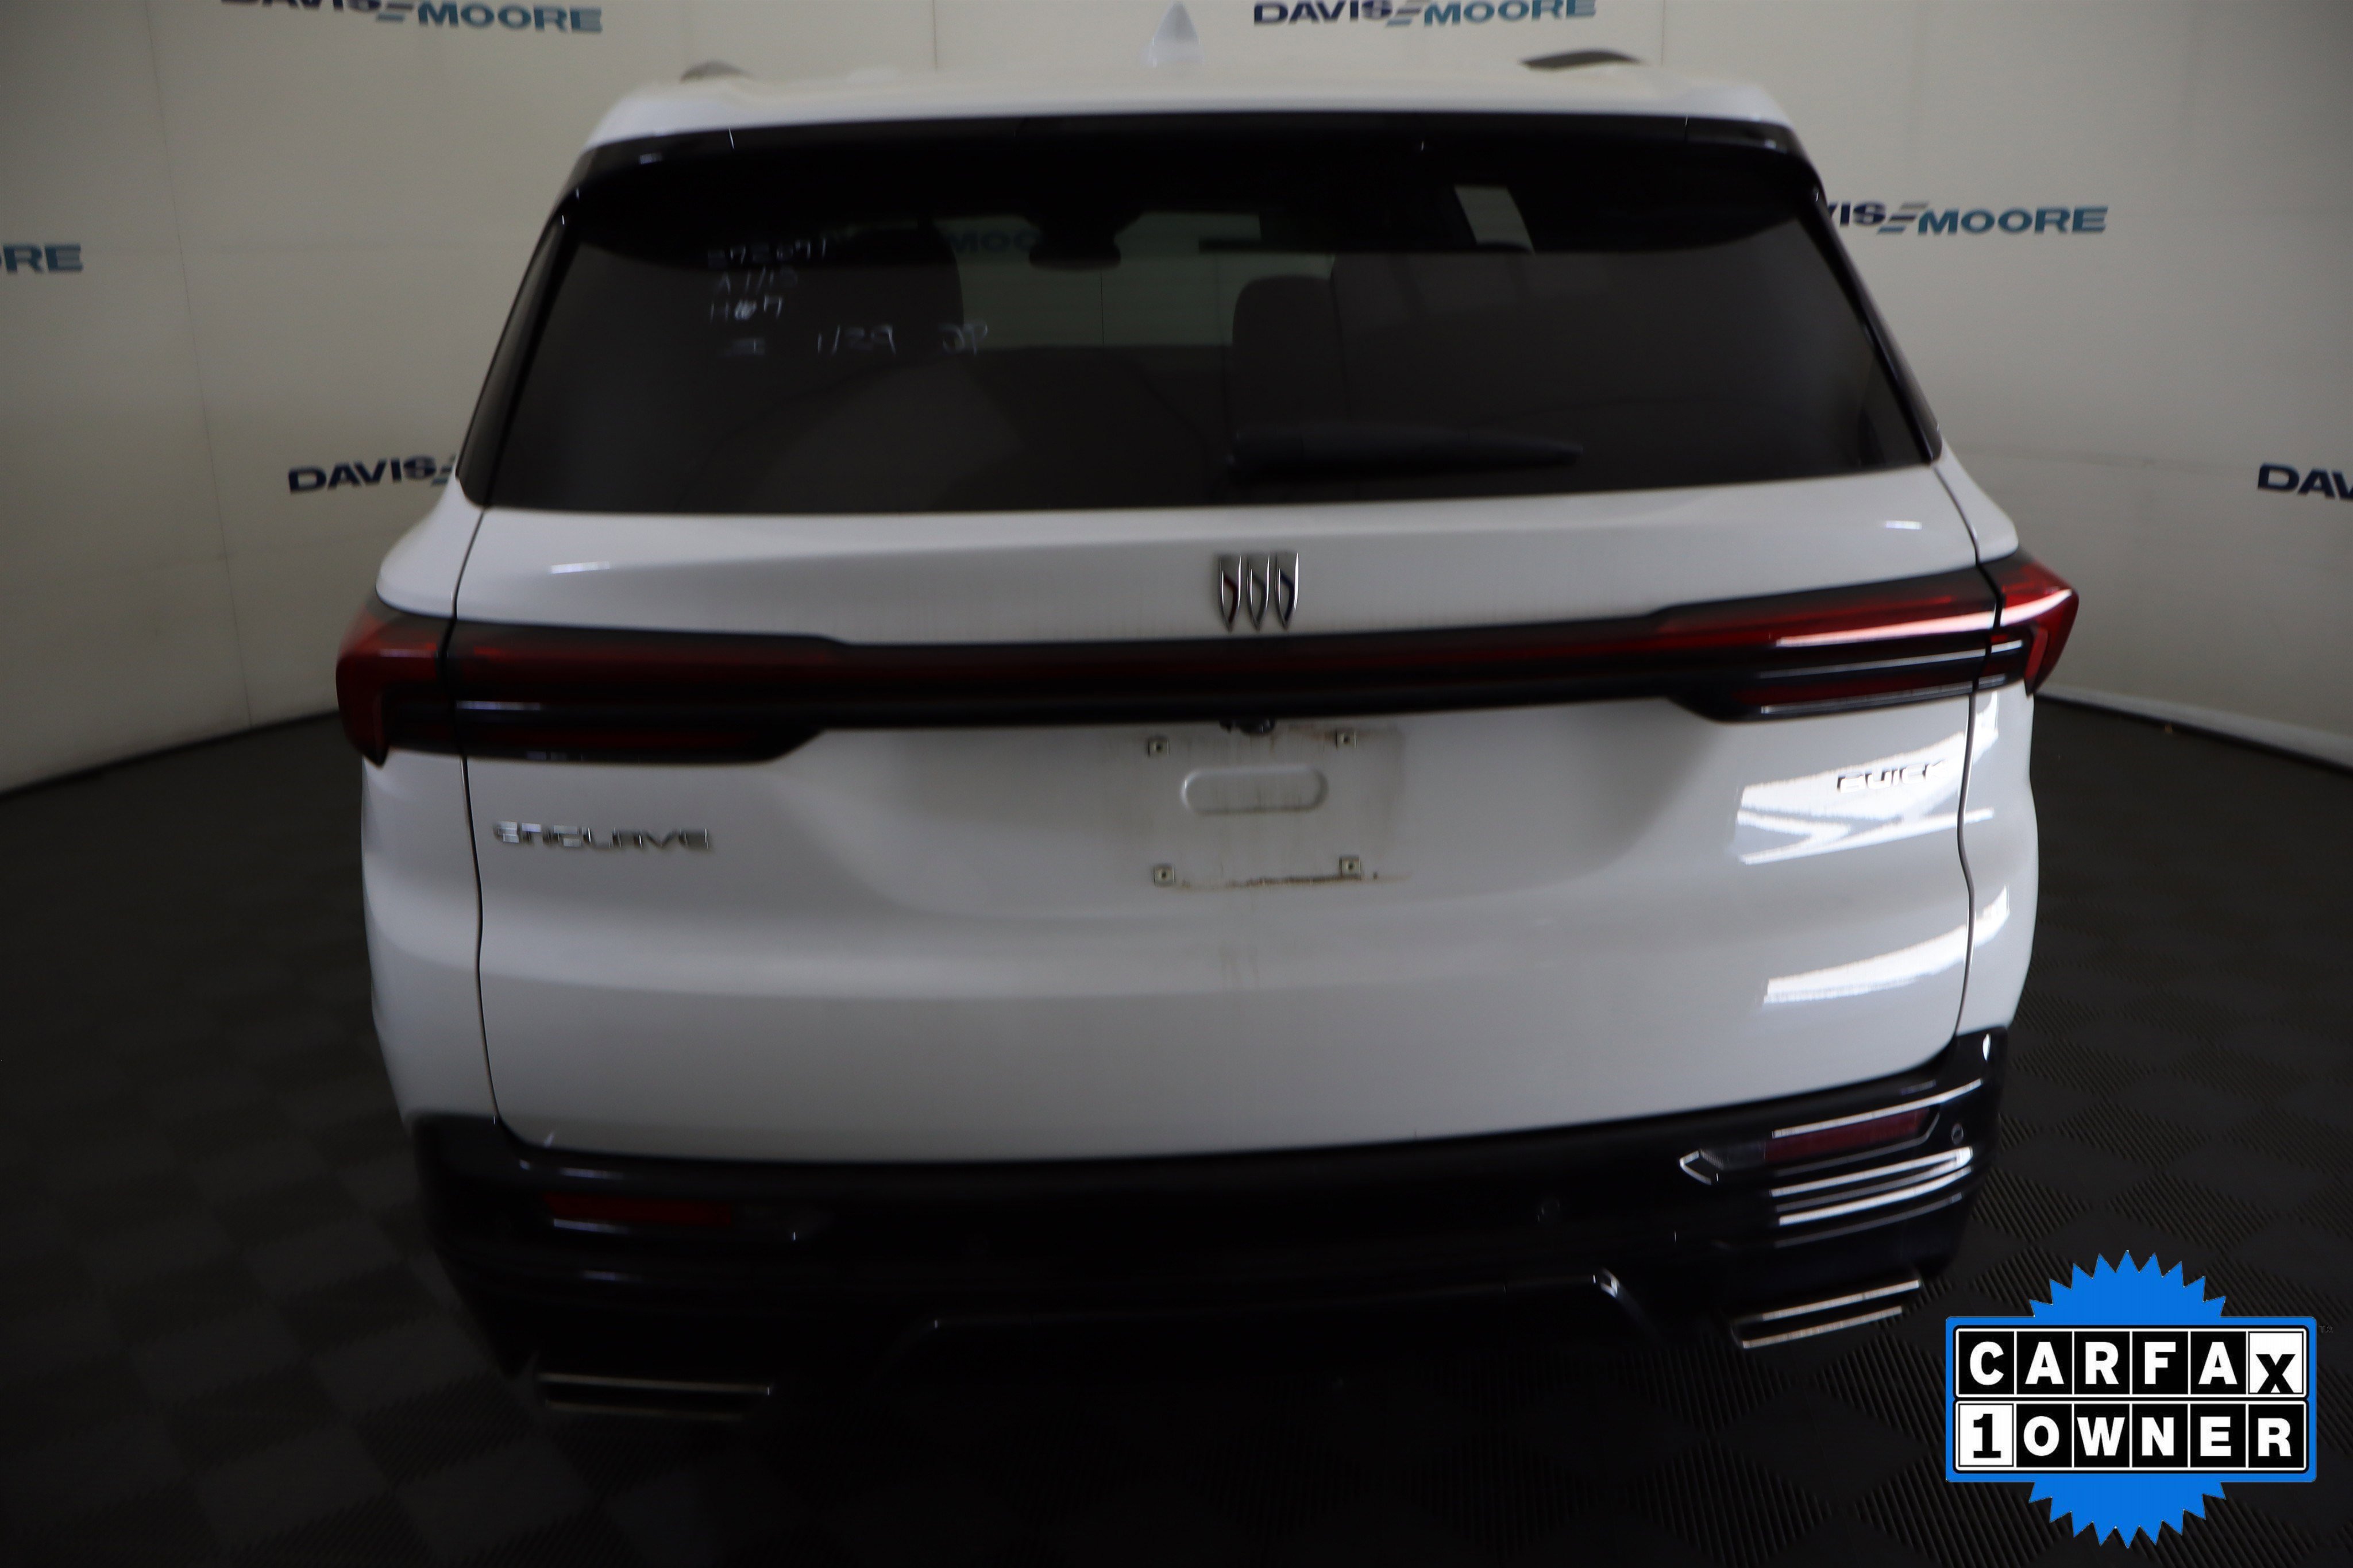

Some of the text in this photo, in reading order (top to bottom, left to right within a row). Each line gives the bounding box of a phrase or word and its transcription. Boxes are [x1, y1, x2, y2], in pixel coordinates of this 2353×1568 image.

[418, 2, 603, 34] MOORE
[1253, 0, 1596, 26] DAVIS MOORE
[1917, 204, 2109, 236] MOORE
[944, 229, 1042, 253] MOO
[288, 455, 436, 492] DAVIS
[2255, 461, 2353, 501] DAV
[492, 820, 713, 852] ENCLAVE
